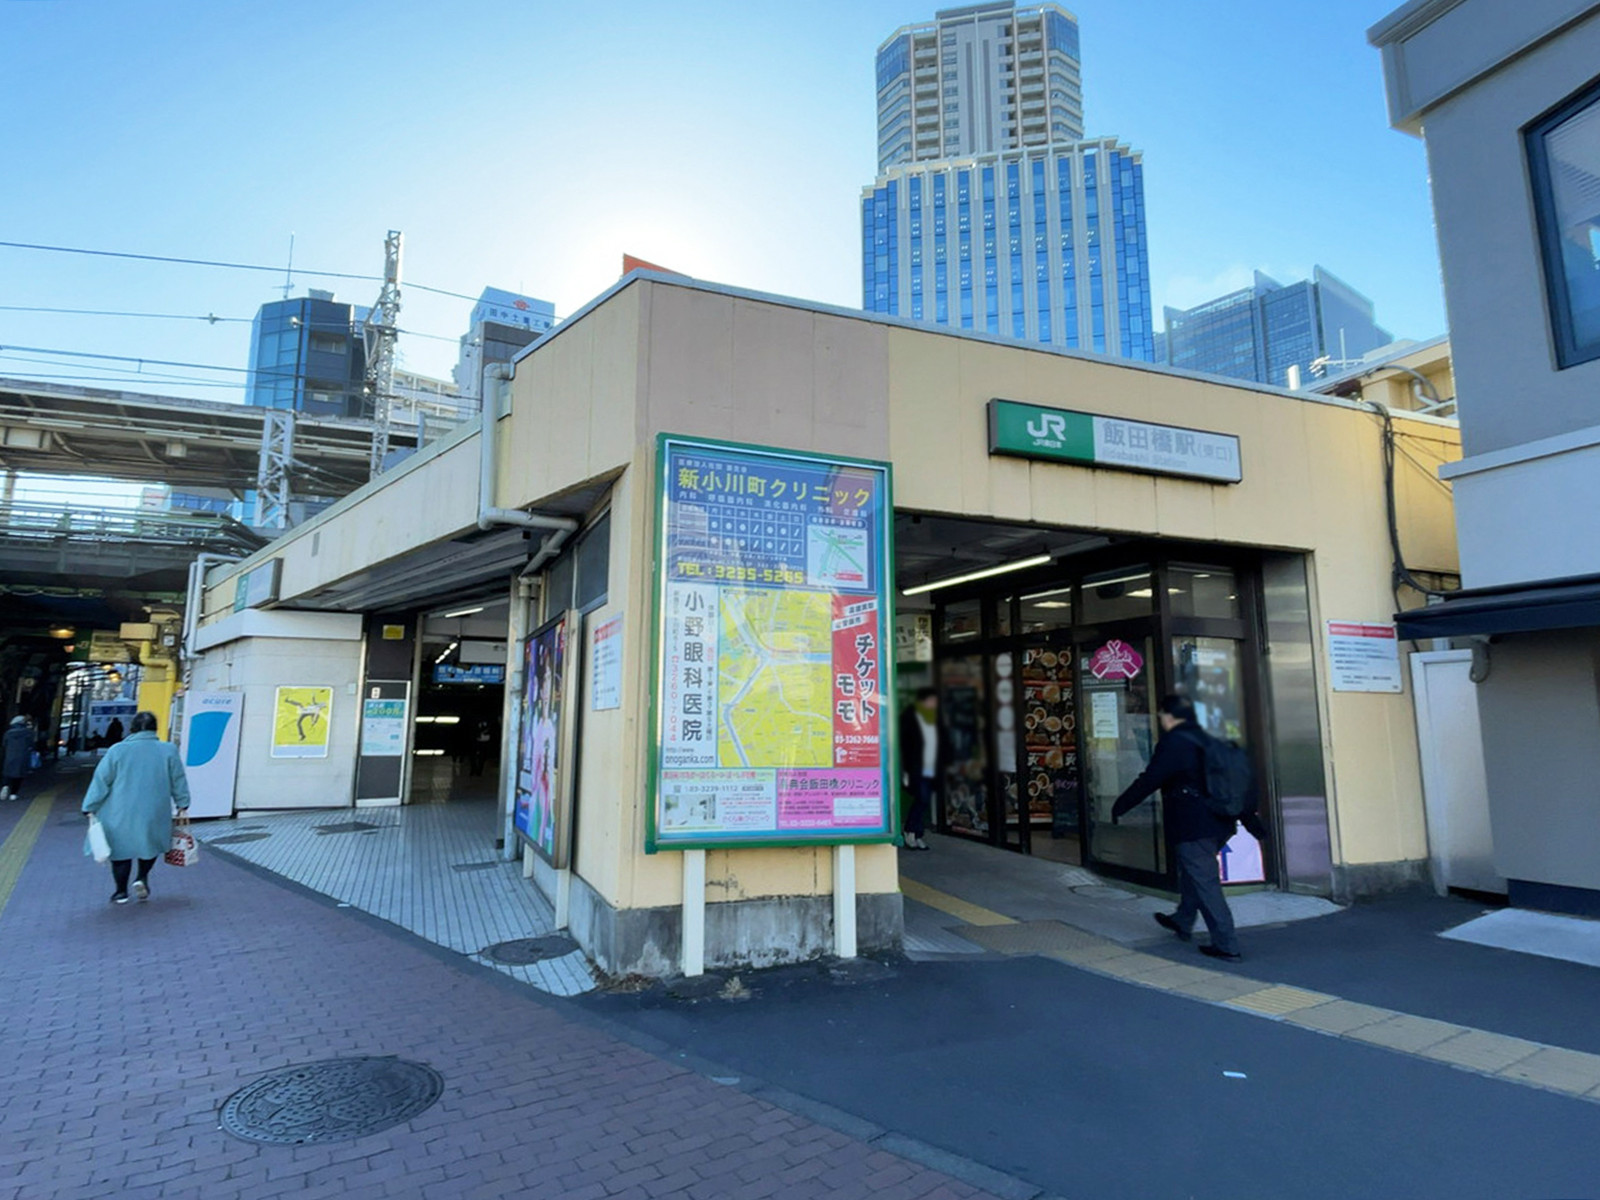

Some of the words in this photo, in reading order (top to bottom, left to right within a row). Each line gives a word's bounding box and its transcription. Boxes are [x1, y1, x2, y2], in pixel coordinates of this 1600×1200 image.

[1026, 413, 1067, 441] JR
[678, 467, 870, 507] 新小川町クリニック
[682, 591, 705, 742] 小野眼科医院
[855, 634, 875, 723] チケット
[837, 674, 855, 722] モモ
